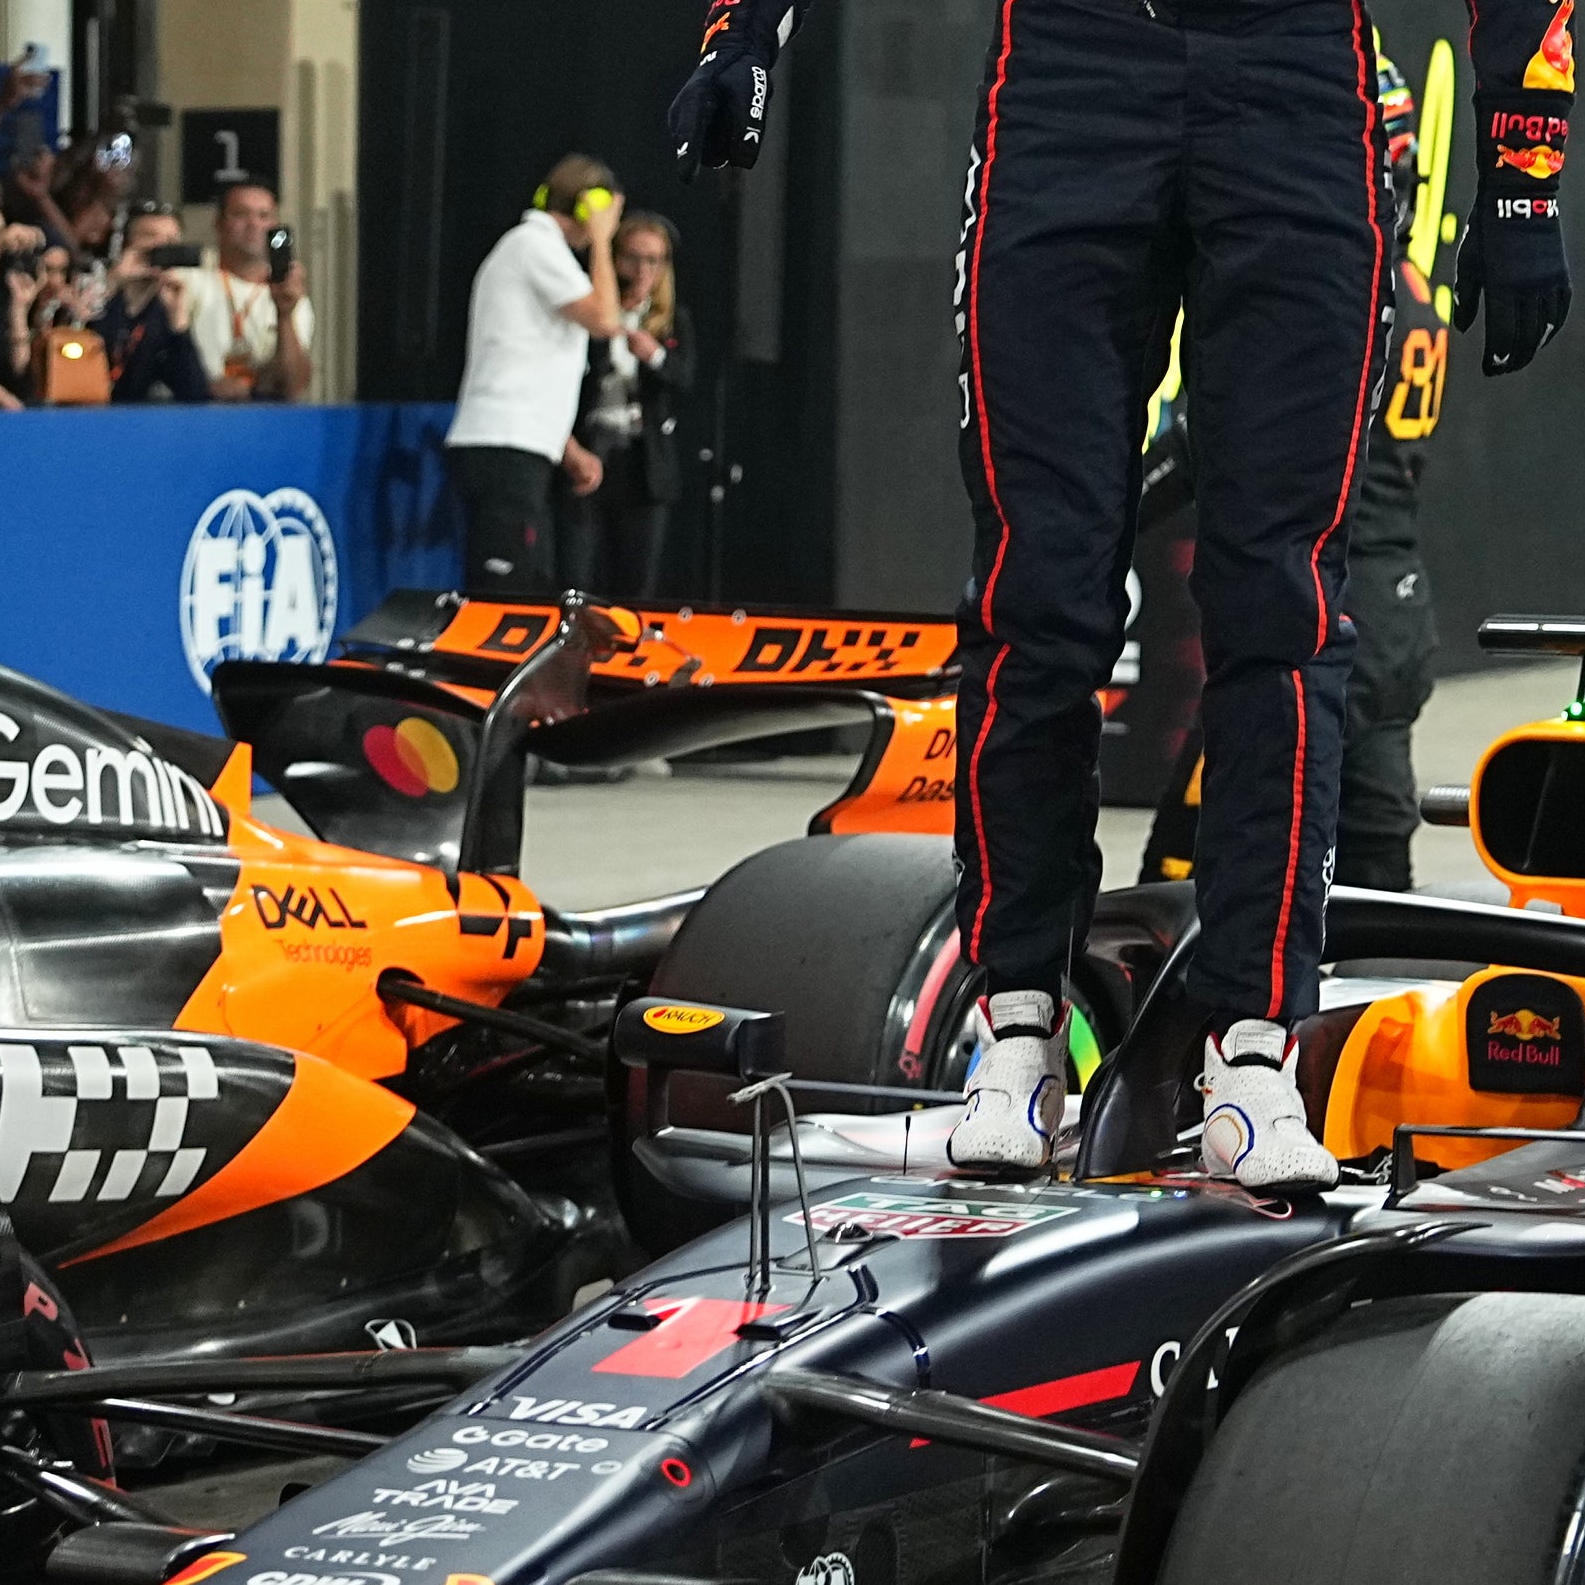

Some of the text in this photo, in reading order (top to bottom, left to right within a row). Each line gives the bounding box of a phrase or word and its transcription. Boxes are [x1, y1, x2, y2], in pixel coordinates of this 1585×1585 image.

[749, 66, 768, 121] sparco
[1490, 112, 1545, 142] Bull
[214, 130, 251, 182] 1
[1385, 328, 1449, 440] 81
[192, 534, 320, 660] FIA
[251, 883, 369, 930] DELL
[275, 938, 372, 973] Technologies
[1487, 1040, 1560, 1066] Red Bull
[591, 1297, 794, 1379] 1
[509, 1395, 649, 1430] VISA
[490, 1428, 609, 1454] Gate
[464, 1455, 581, 1481] AT&T
[372, 1487, 520, 1515] TRADE
[283, 1545, 437, 1571] CARLYLE
